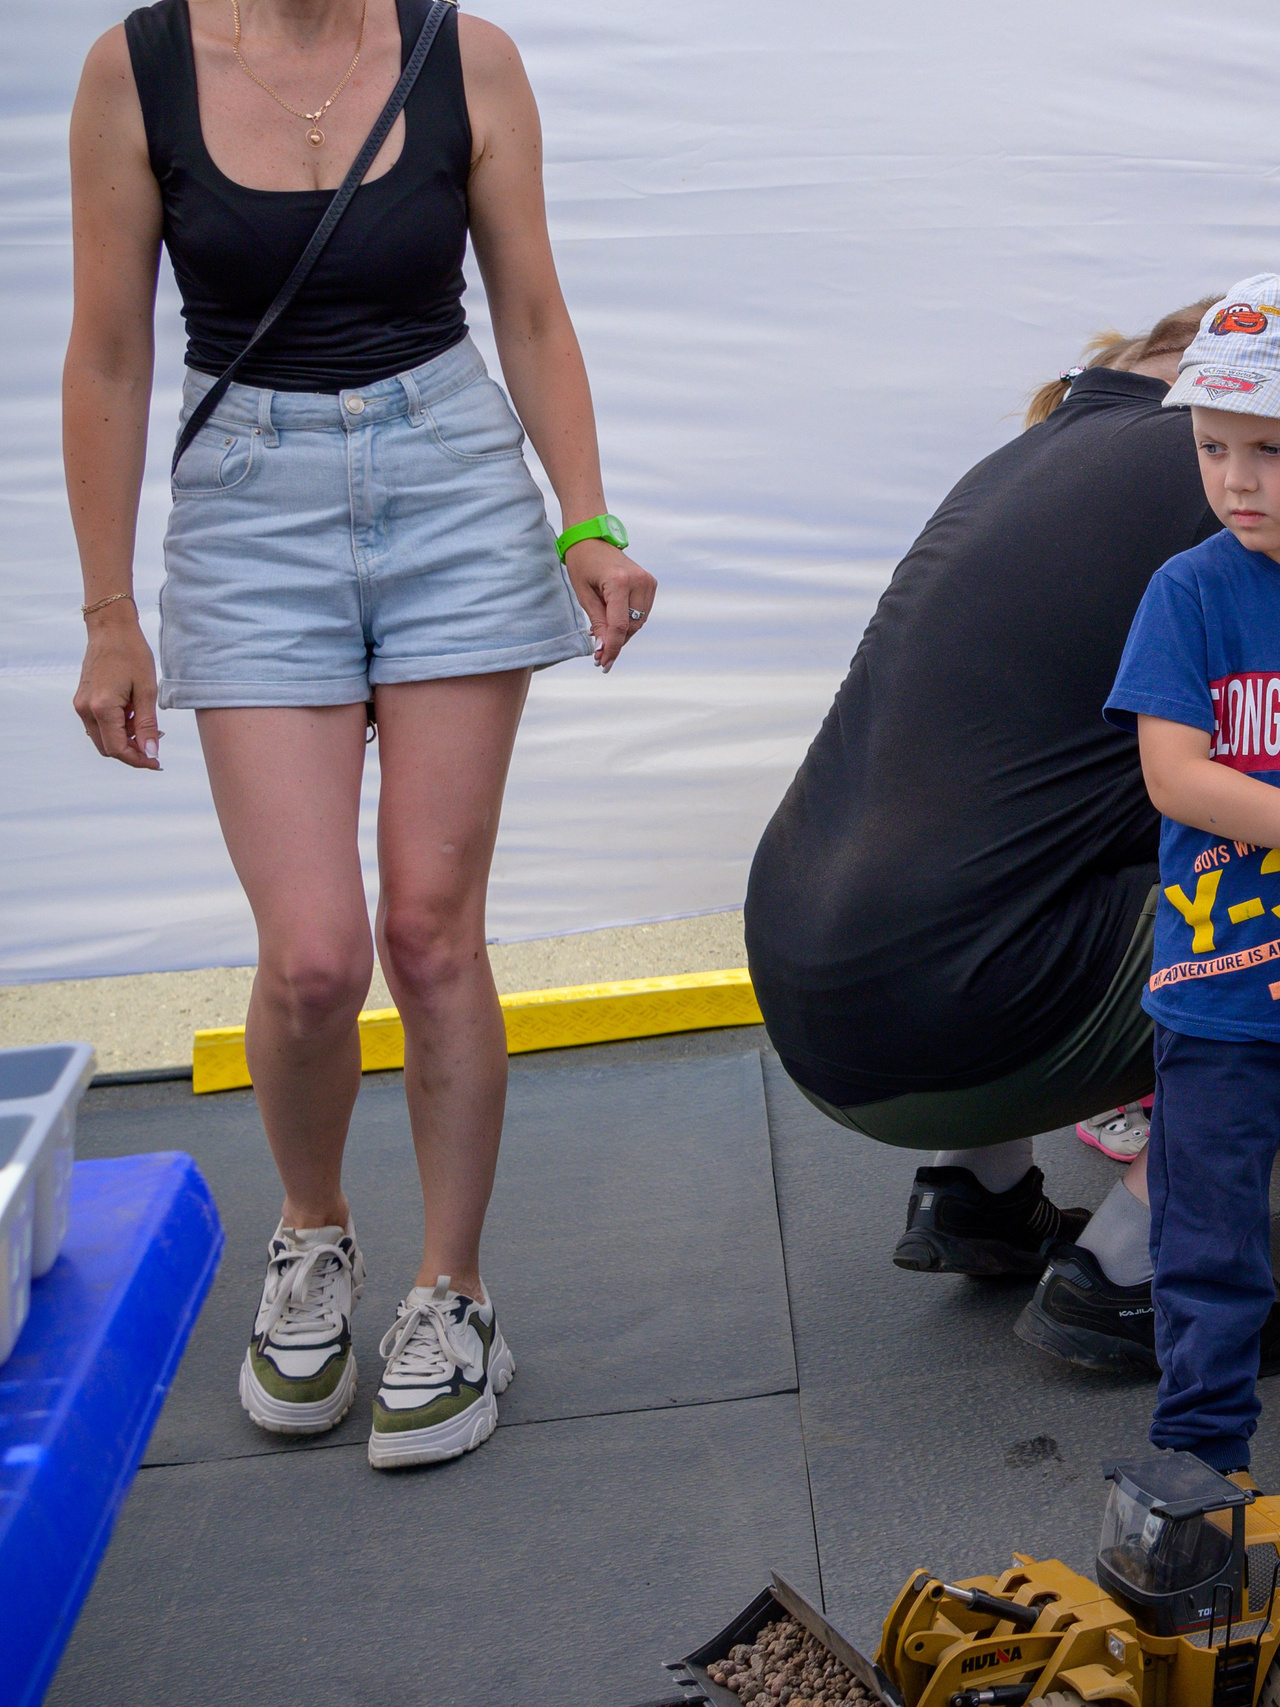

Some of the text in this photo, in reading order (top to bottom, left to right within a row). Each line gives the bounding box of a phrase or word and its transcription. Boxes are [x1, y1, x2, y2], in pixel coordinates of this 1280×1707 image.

[1194, 844, 1231, 873] BOYS
[1163, 954, 1244, 982] ADVENTURE
[1249, 949, 1263, 963] IS
